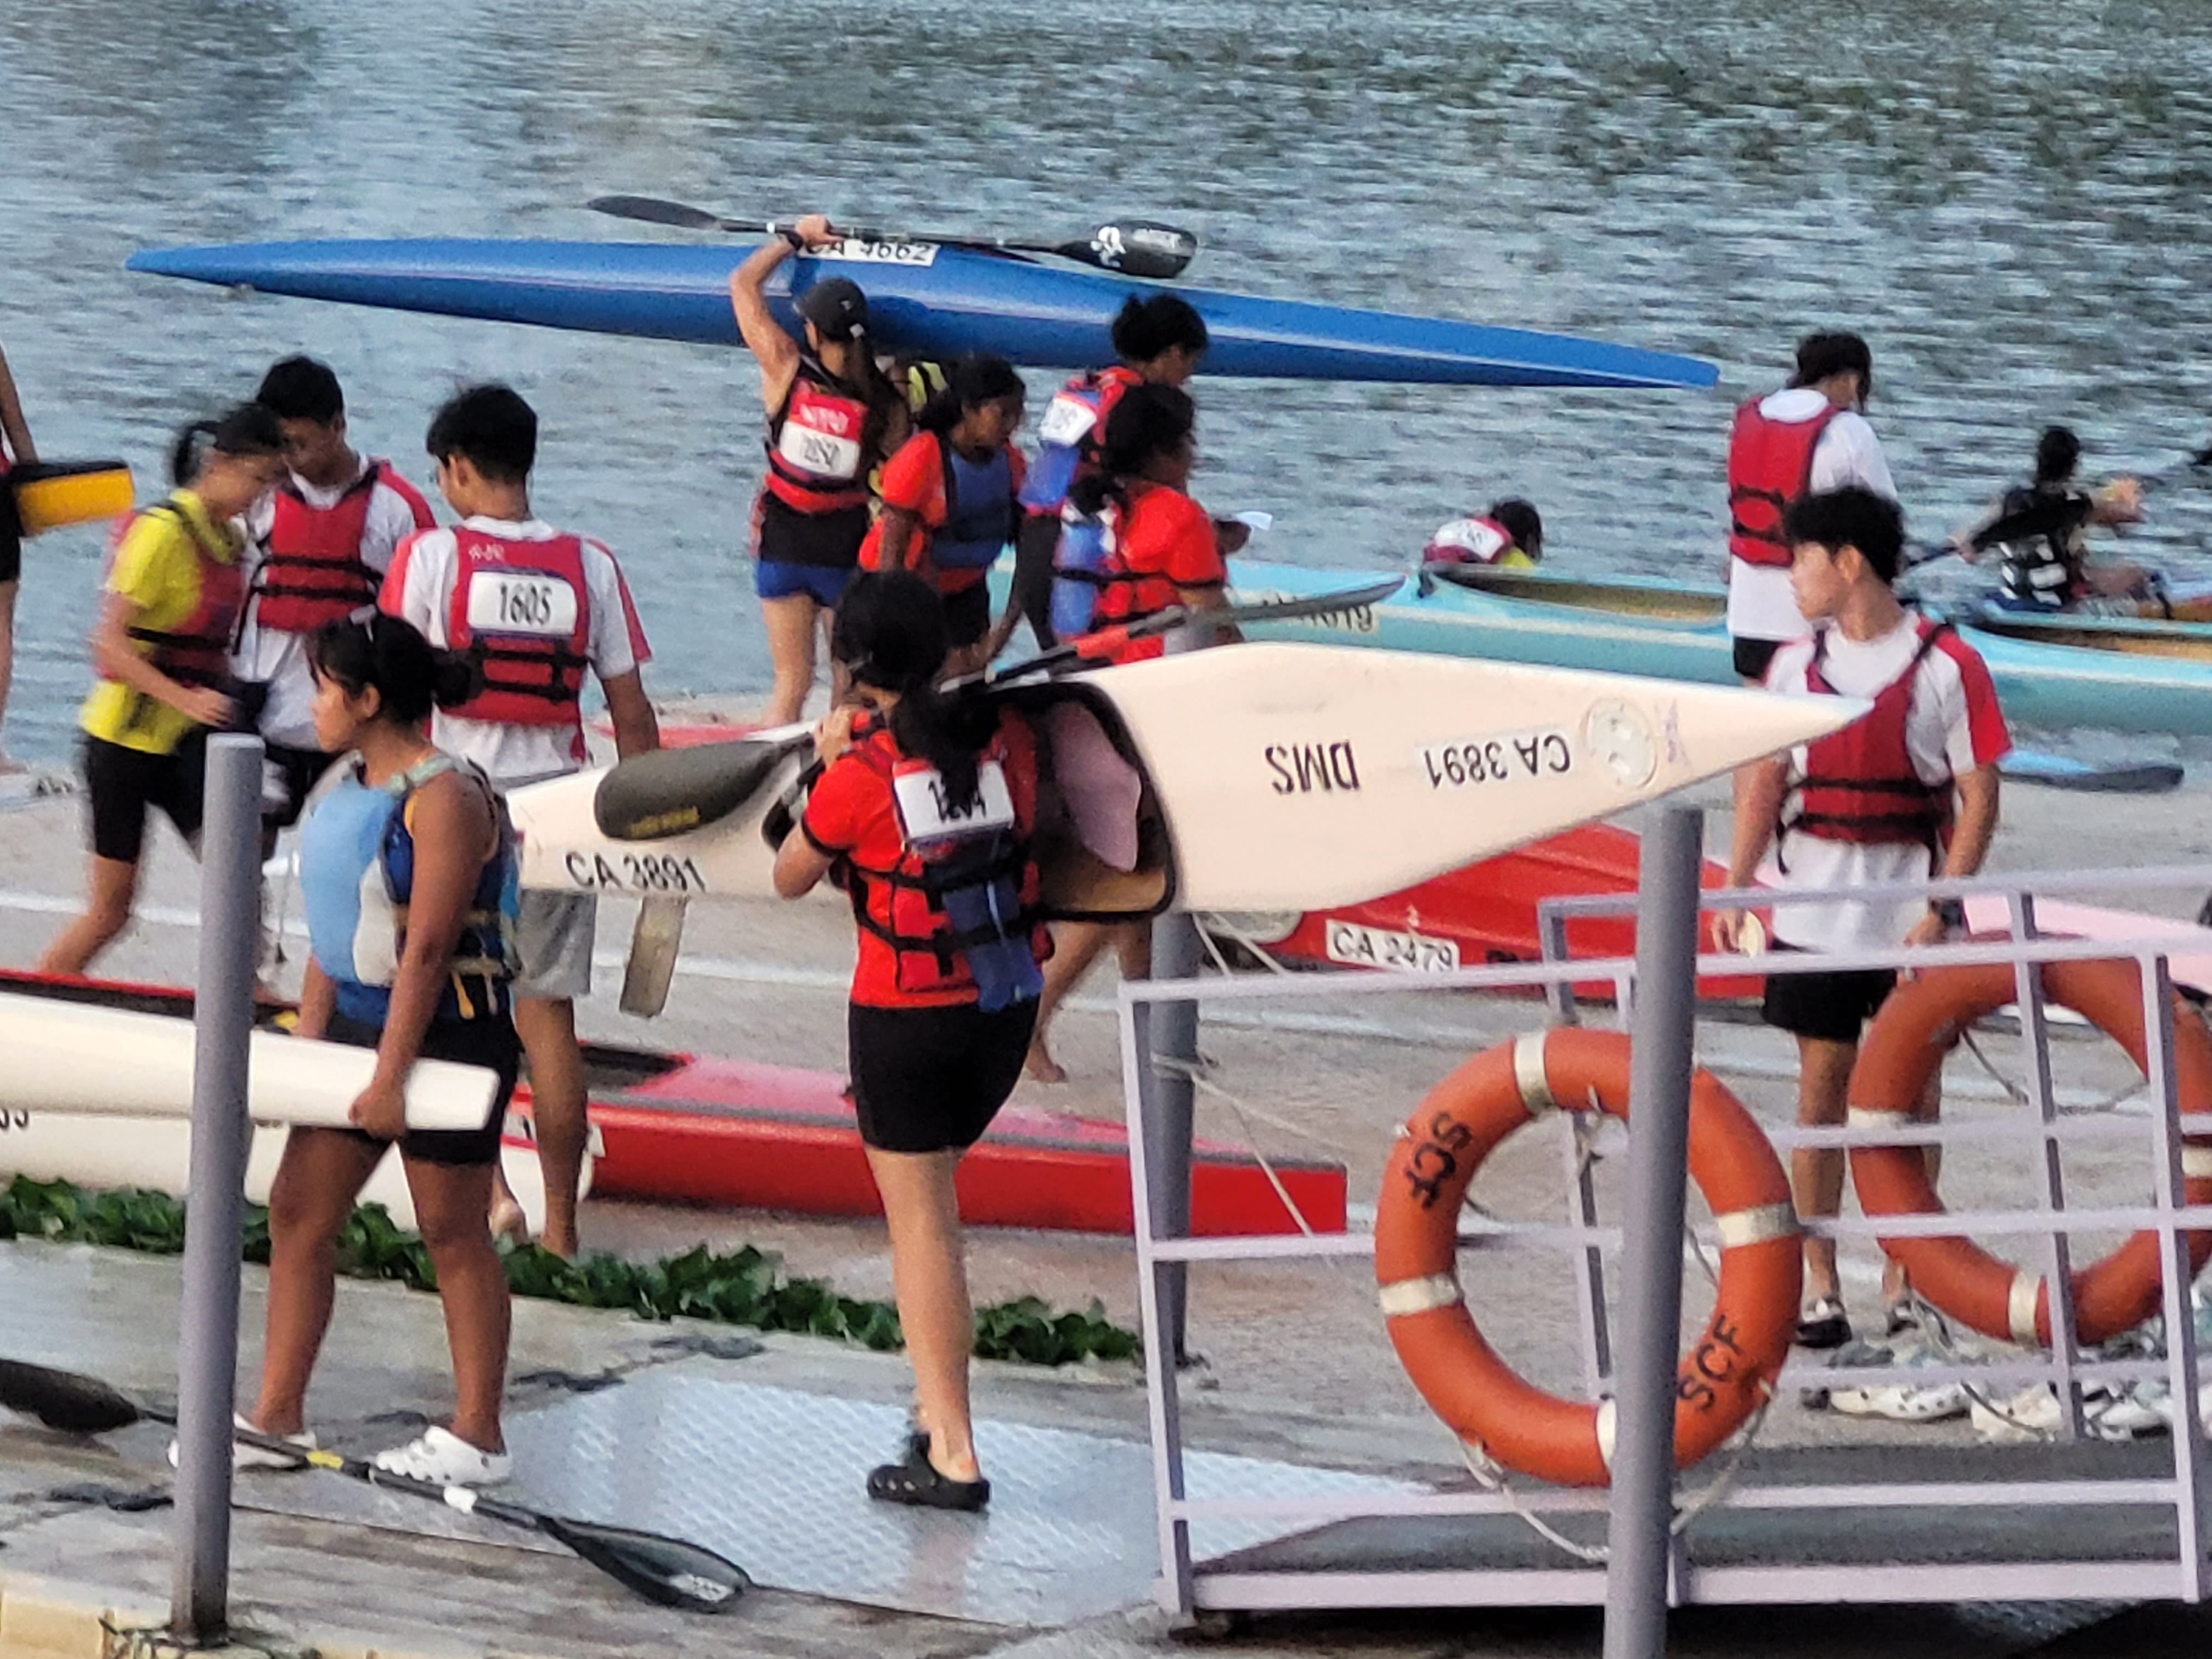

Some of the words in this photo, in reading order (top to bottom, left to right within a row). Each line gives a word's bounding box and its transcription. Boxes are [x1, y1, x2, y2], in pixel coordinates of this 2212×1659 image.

[1263, 740, 1360, 794] DMS
[1425, 741, 1508, 789] 3891
[1513, 733, 1571, 777] CA
[565, 851, 623, 890] CA
[622, 853, 707, 893] 3891
[1333, 927, 1376, 961] CA
[1676, 1314, 1743, 1411] SCF
